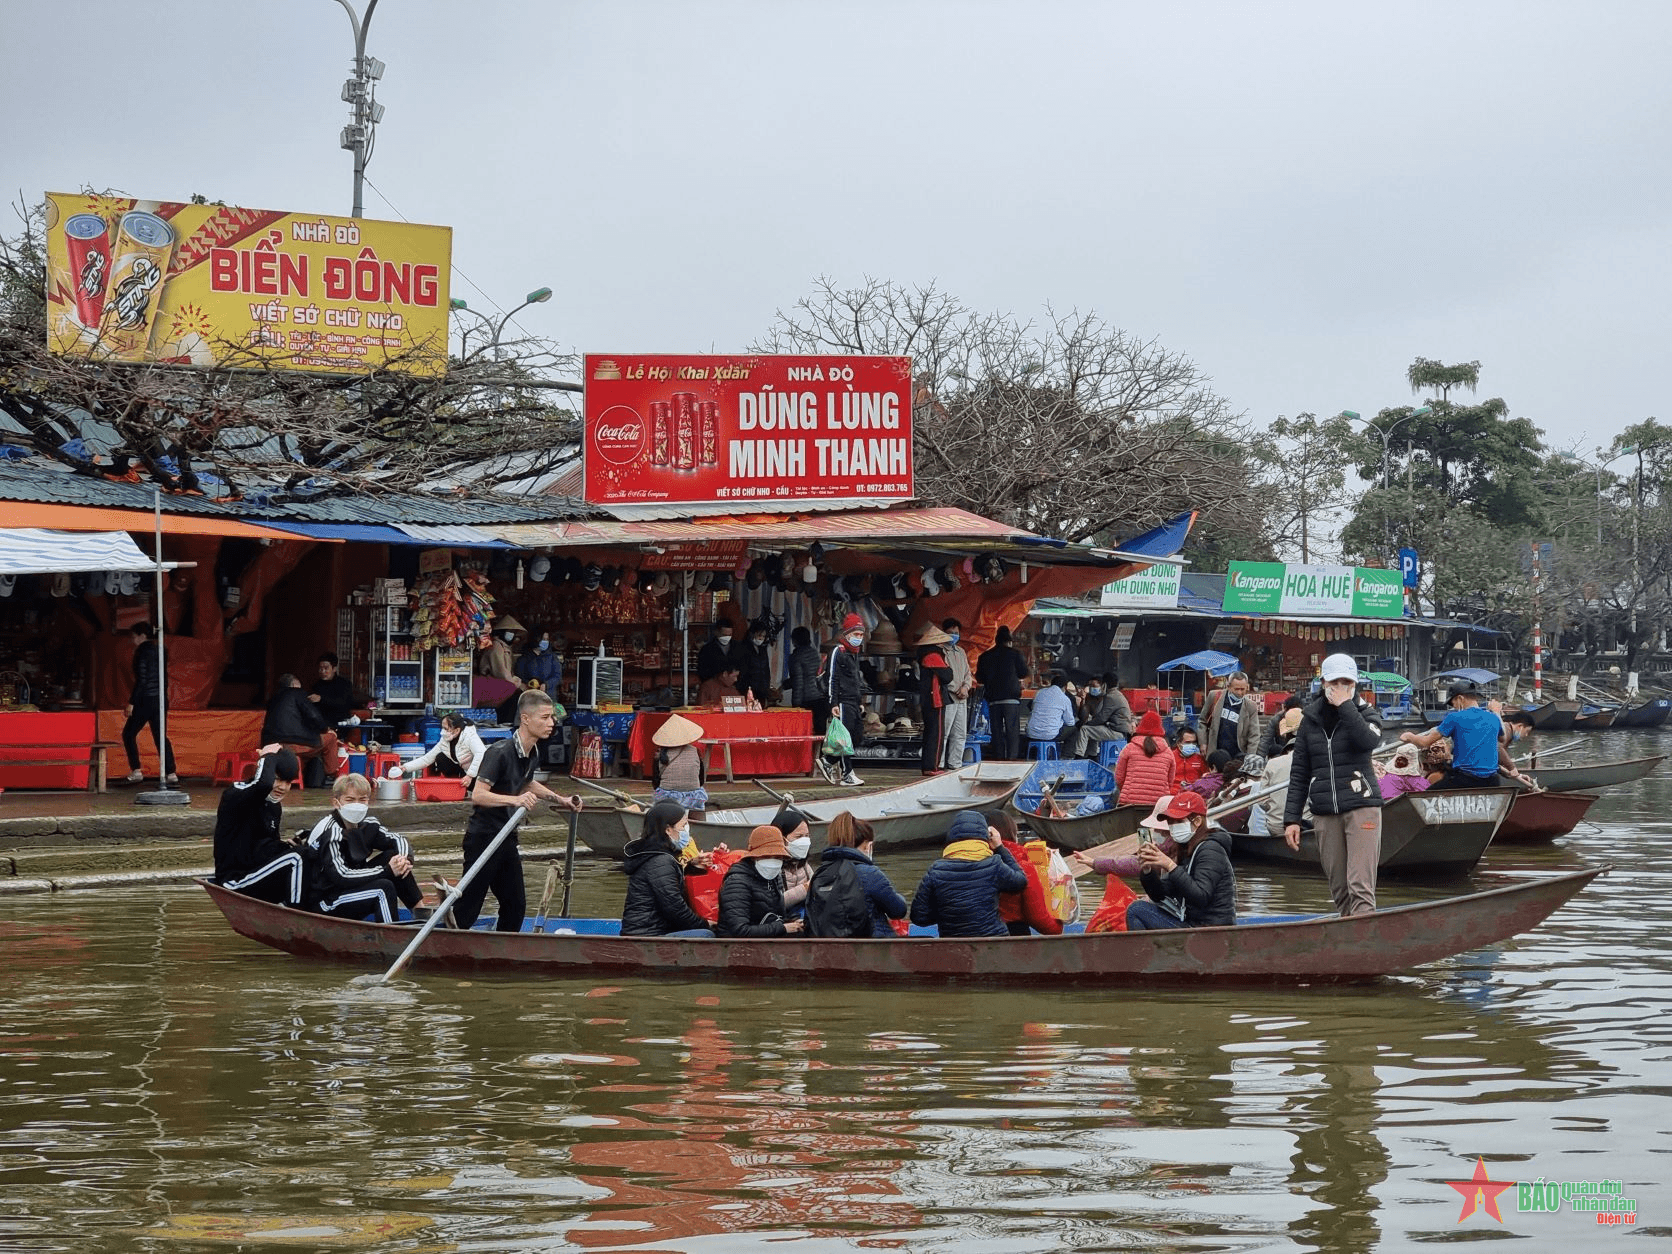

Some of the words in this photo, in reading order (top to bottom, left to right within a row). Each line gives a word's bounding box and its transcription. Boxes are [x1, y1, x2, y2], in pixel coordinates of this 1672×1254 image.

[292, 220, 330, 242] NHÀ
[335, 222, 361, 245] ĐÒ
[210, 231, 308, 298] BIỂN
[322, 247, 438, 307] ĐÔNG
[250, 298, 289, 322] VIẾT
[293, 303, 320, 325] SỚ
[325, 307, 361, 327] CHỮ
[366, 311, 402, 330] NHO
[626, 363, 644, 379] Lễ
[648, 366, 673, 382] Hội
[677, 366, 709, 379] Khai
[788, 364, 825, 381] NHÀ
[829, 364, 854, 381] ĐÒ
[738, 384, 818, 430] DŨNG
[827, 384, 899, 430] LÙNG
[729, 439, 806, 478] MINH
[814, 438, 907, 476] THANH
[716, 486, 731, 497] VIẾT
[757, 487, 770, 495] NHO
[1404, 556, 1414, 579] P
[1231, 571, 1281, 592] Kangaroo
[1285, 573, 1317, 598] HOA
[1355, 577, 1399, 598] Kangaroo
